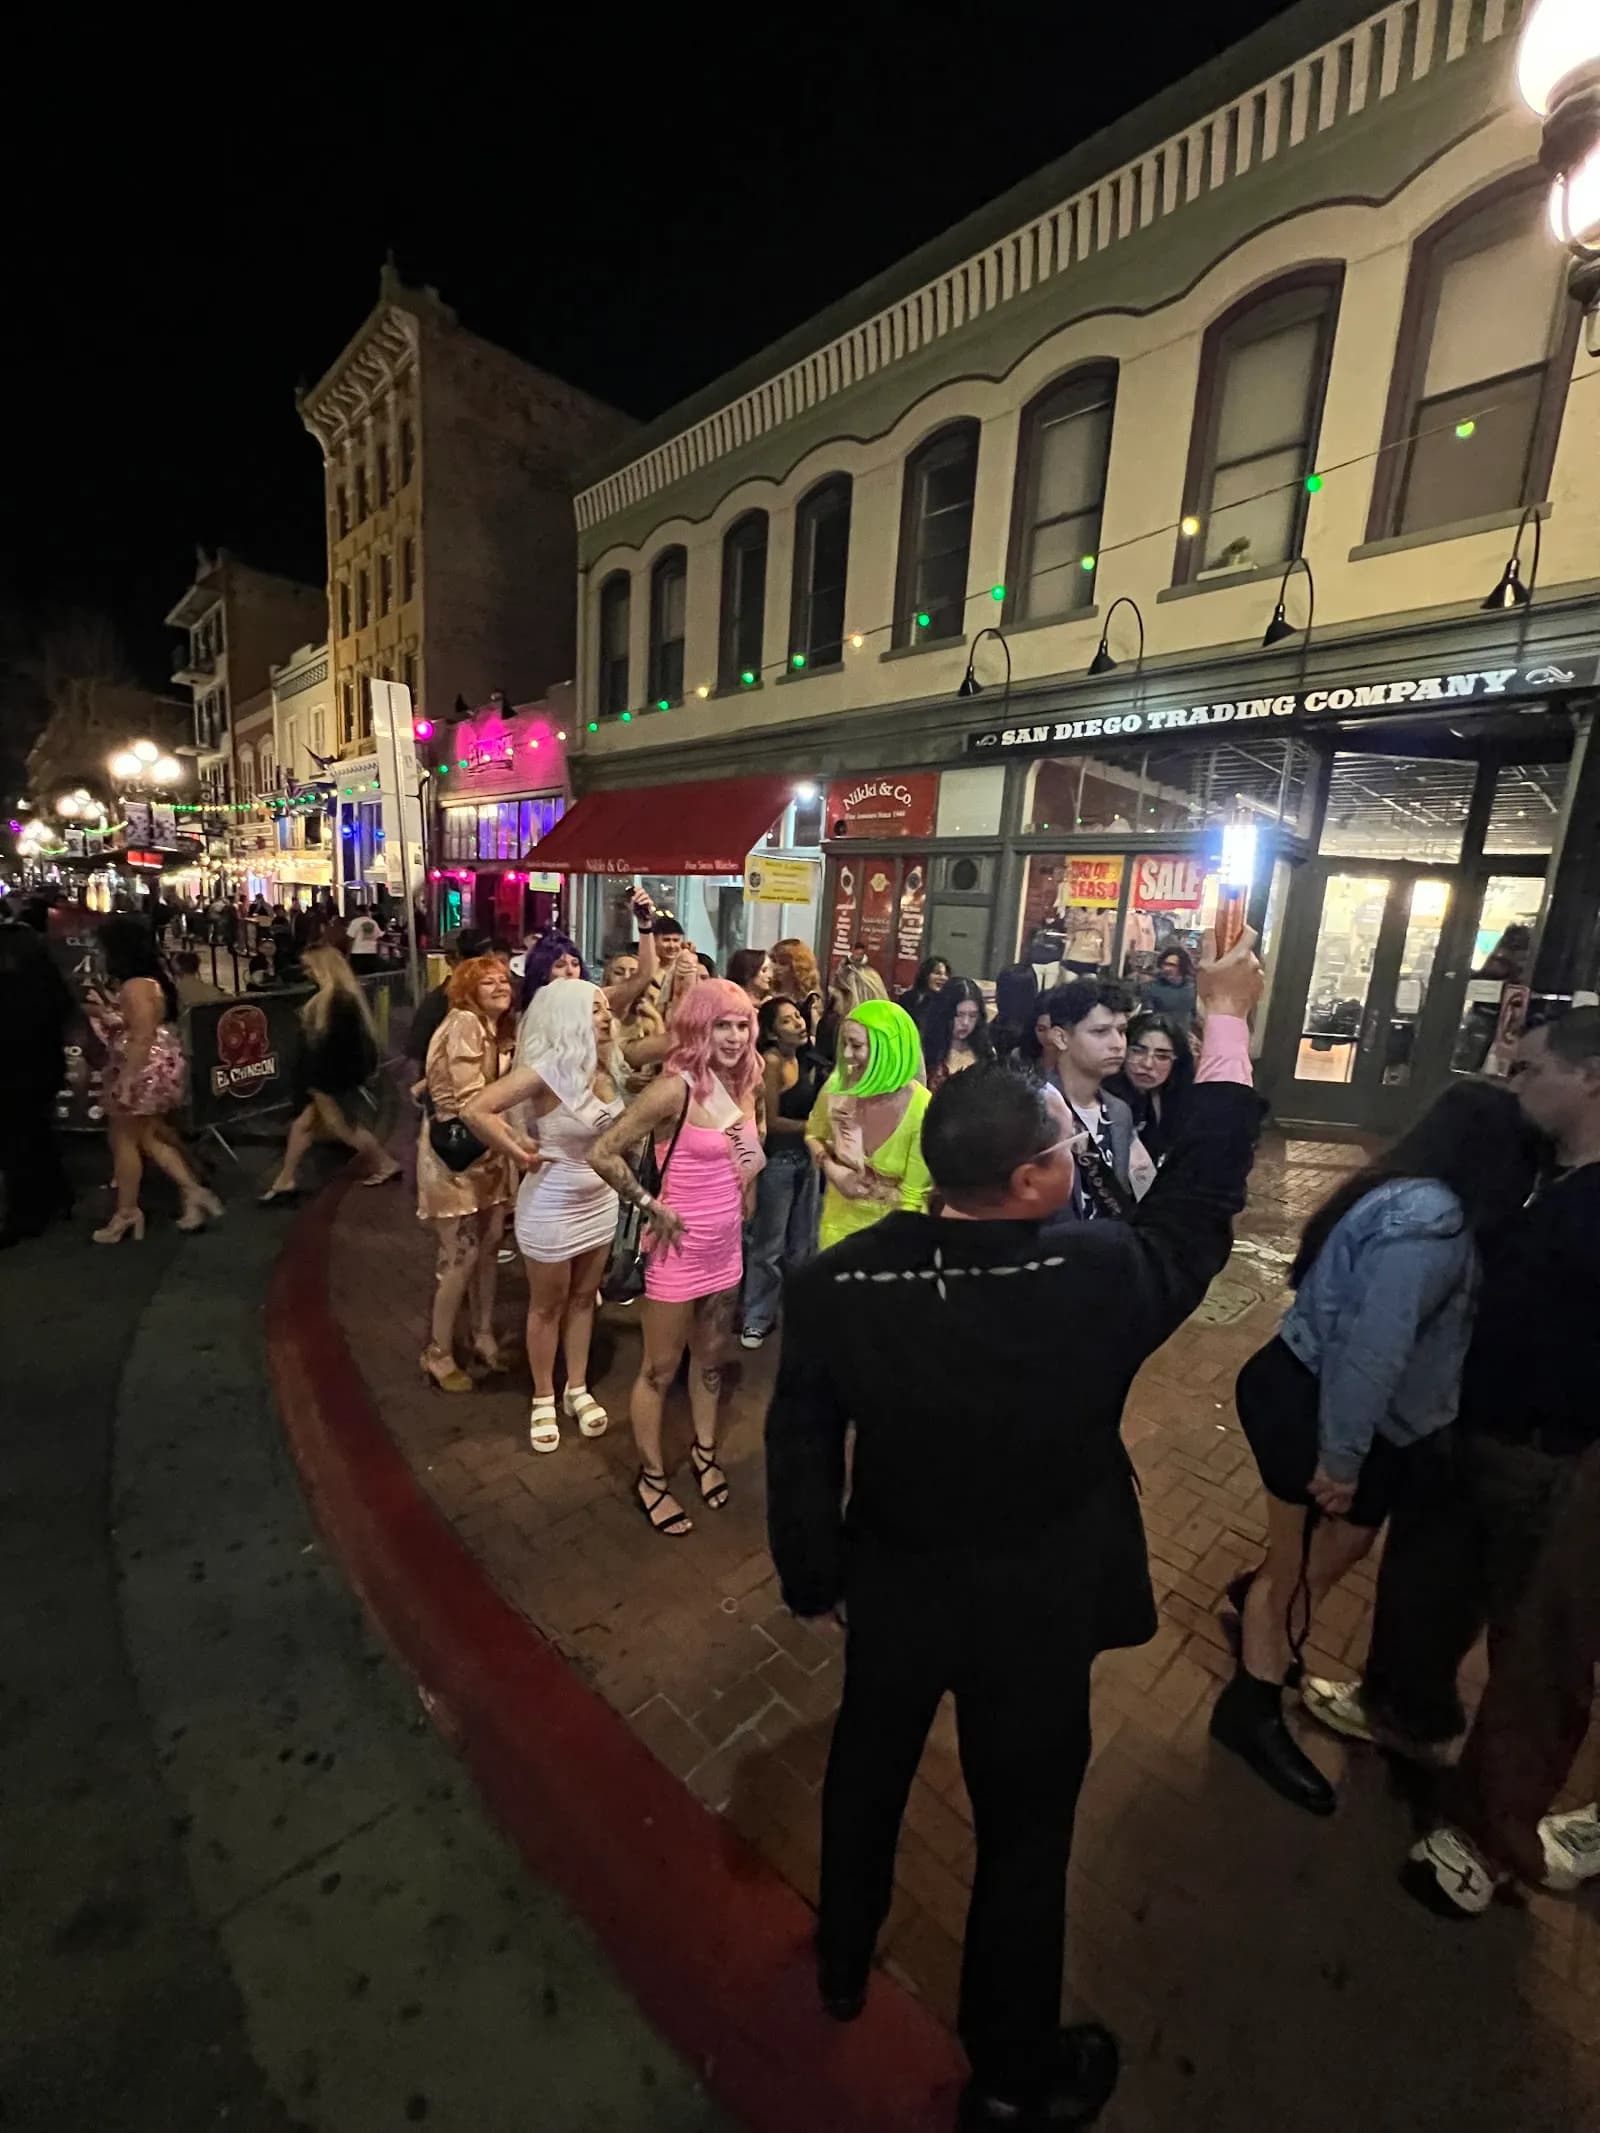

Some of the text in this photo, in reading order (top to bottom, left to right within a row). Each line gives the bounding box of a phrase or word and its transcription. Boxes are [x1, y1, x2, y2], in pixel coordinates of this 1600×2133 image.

[1001, 669, 1518, 746] SAN DIEGO TRADING COMPANY
[843, 782, 912, 811] Nikki & Co.
[1139, 858, 1200, 901] SALE
[216, 1057, 276, 1089] EL CHINGON
